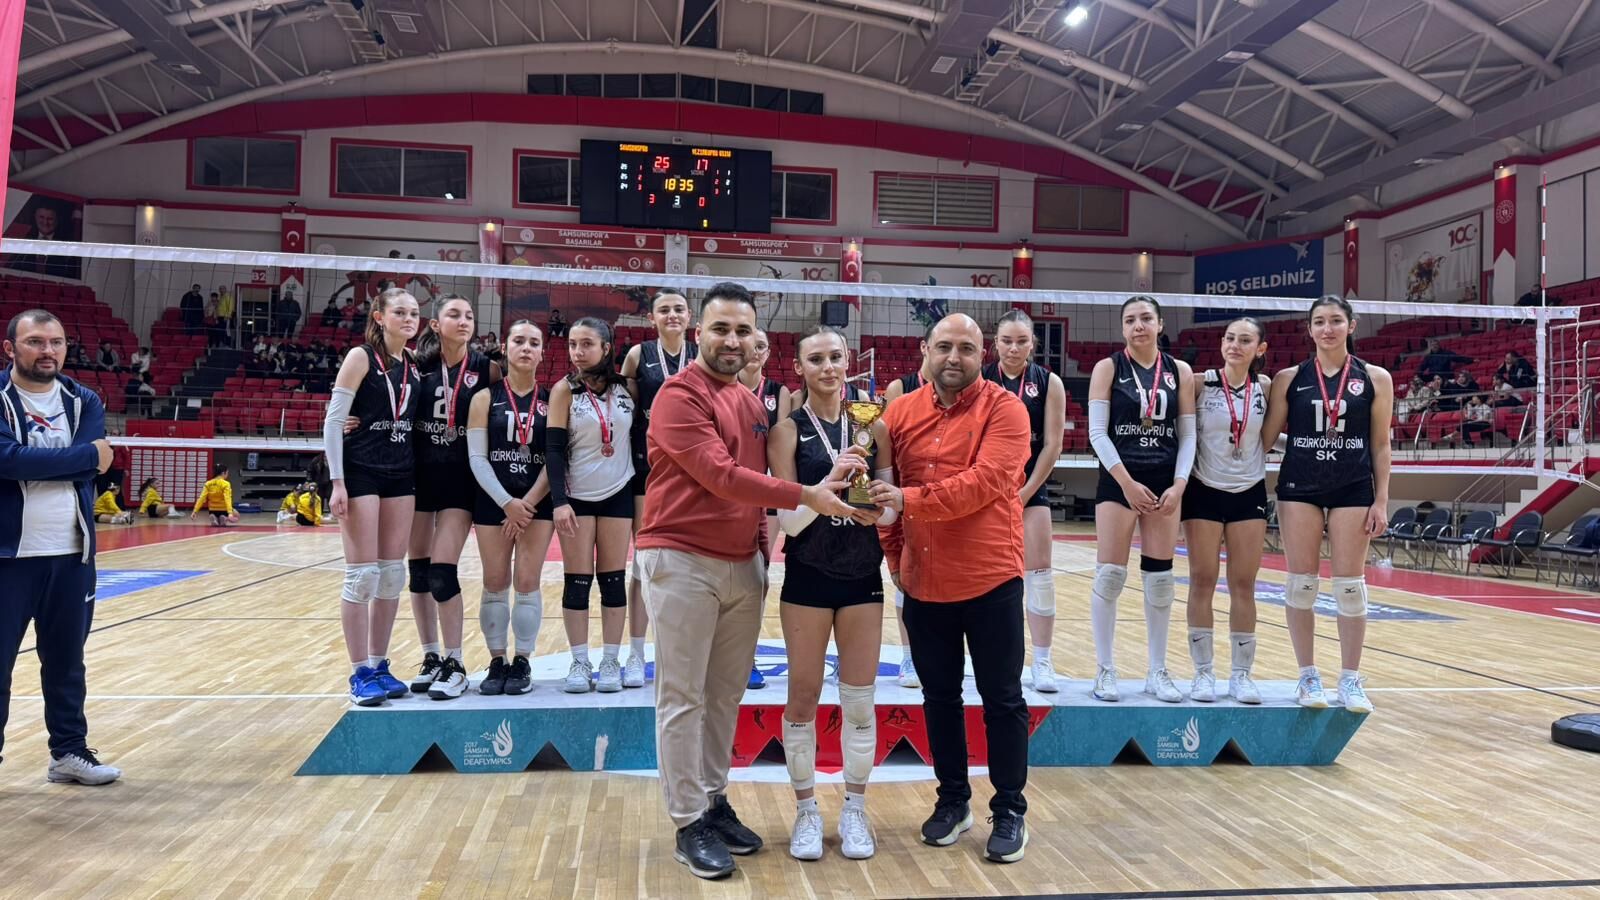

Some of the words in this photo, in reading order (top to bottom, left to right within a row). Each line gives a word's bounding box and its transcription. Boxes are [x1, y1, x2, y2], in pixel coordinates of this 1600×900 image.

[654, 156, 670, 169] 25
[697, 159, 709, 171] 17
[649, 193, 655, 204] 3
[674, 195, 681, 206] 3
[698, 196, 705, 207] 0
[558, 230, 609, 239] SAMSUNSPOR'A
[565, 238, 602, 247] BAŞARILAR
[740, 240, 788, 249] SAMSUNSPOR'A
[747, 247, 782, 256] BAŞARILAR
[252, 271, 266, 282] B2
[1205, 280, 1237, 296] HOŞ
[1240, 267, 1316, 291] GELDİNİZ
[1043, 303, 1055, 313] B1
[433, 385, 454, 419] 2
[1135, 388, 1168, 420] 10
[1311, 399, 1348, 433] 12
[390, 432, 406, 443] SK
[431, 434, 450, 446] SK
[1139, 437, 1160, 447] SK
[1293, 435, 1344, 449] VEZİRKÖPRÜ
[1315, 450, 1337, 461] SK
[509, 463, 528, 474] SK
[831, 514, 855, 526] SK
[1156, 751, 1199, 760] DEAFLYMPICS
[464, 758, 512, 766] DEAFLYMPICS
